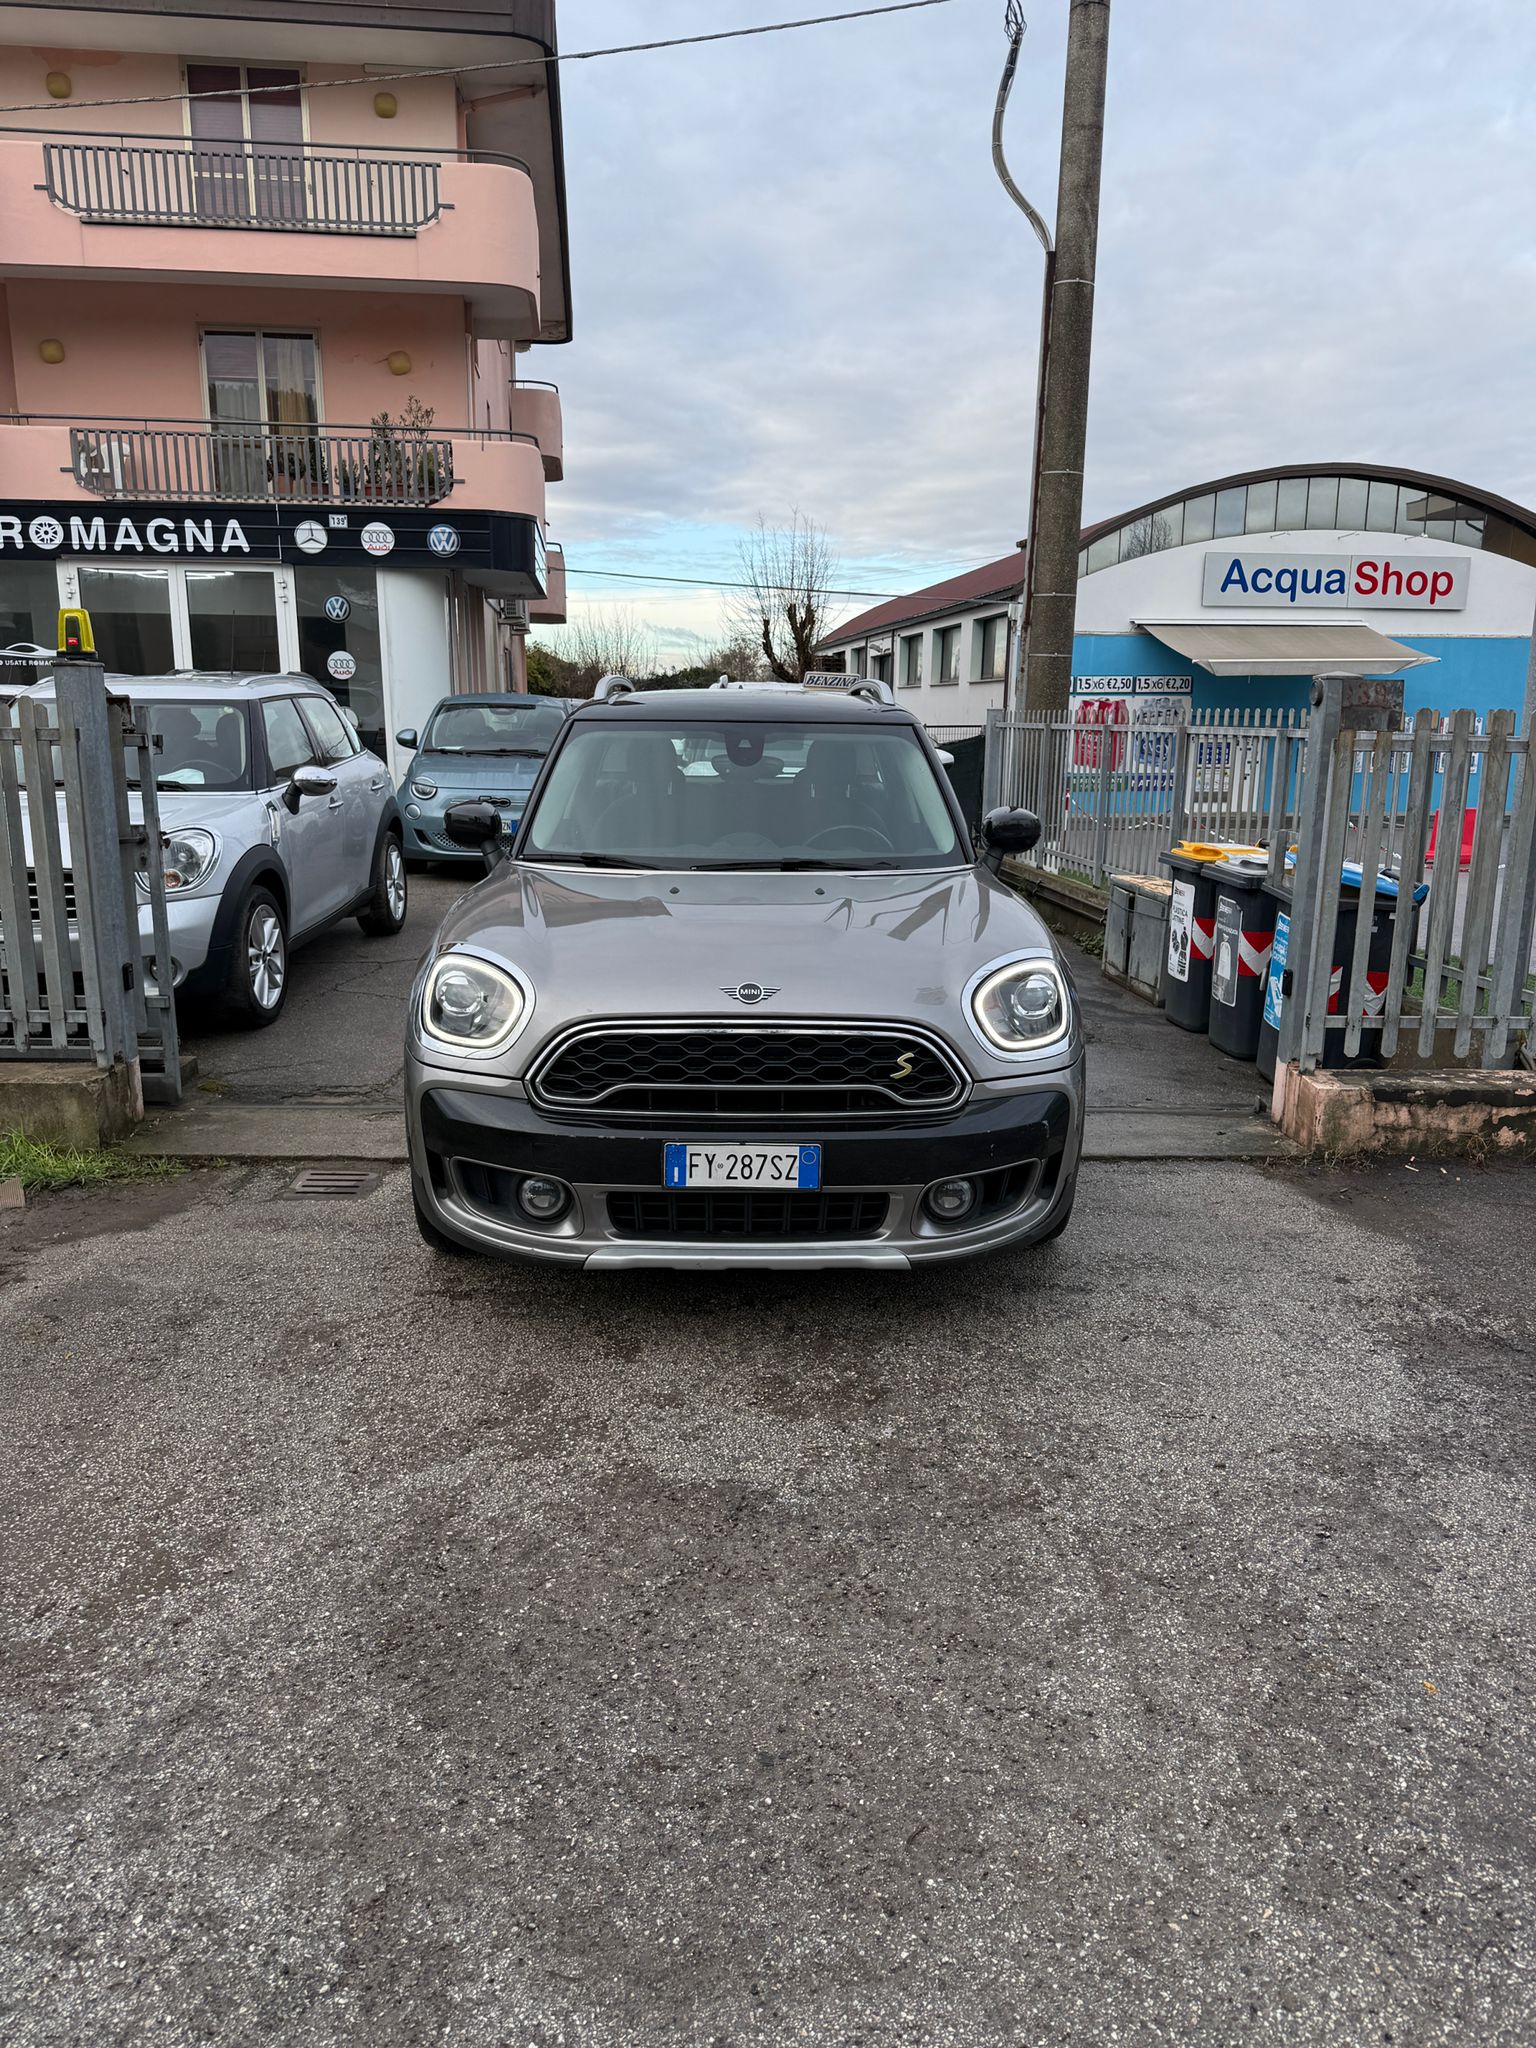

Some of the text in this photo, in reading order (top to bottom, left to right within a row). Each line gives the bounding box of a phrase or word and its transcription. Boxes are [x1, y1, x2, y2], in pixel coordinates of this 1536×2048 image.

[0, 516, 251, 552] ROMAGNA
[1220, 558, 1454, 604] Acqua Shop
[1093, 679, 1105, 690] x6
[1107, 678, 1131, 691] €2,50
[1137, 678, 1190, 691] 1,5 x6 €2,20
[890, 1052, 915, 1079] S
[689, 1153, 716, 1179] FY
[726, 1153, 798, 1181] 287SZ
